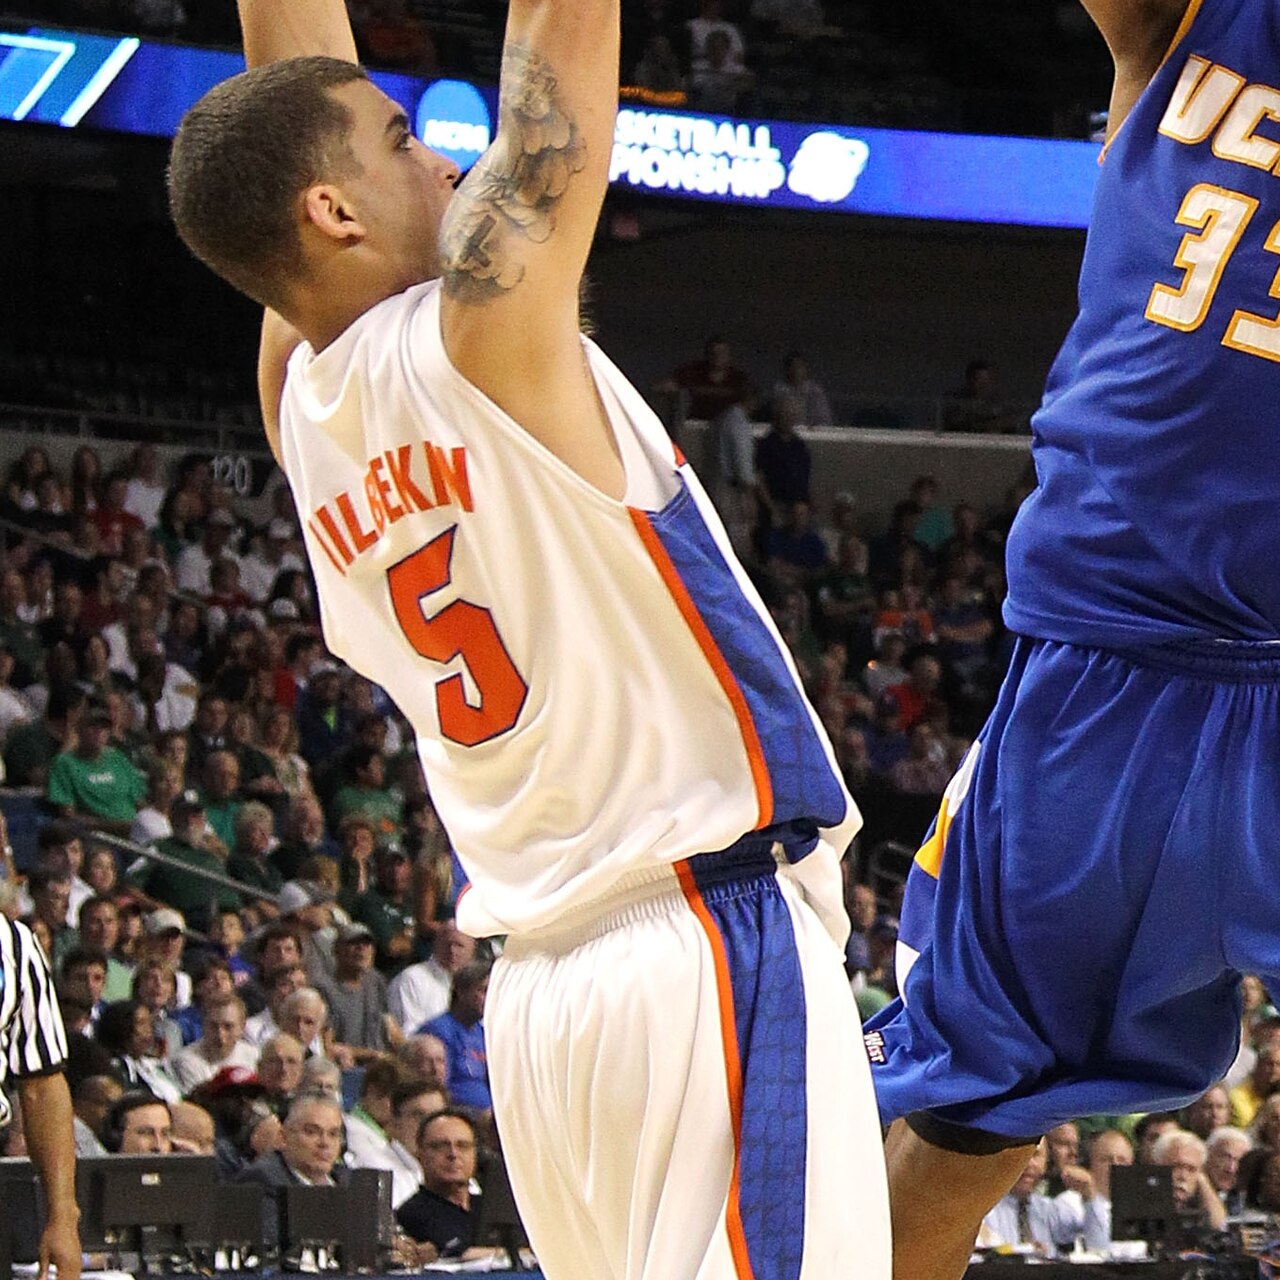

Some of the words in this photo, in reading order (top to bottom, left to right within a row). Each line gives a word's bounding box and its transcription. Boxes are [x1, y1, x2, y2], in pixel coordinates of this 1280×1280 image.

[608, 143, 786, 198] PIONSHIP
[615, 109, 781, 162] SKETBALL
[308, 440, 475, 578] ILBEKIN
[386, 523, 529, 748] 5
